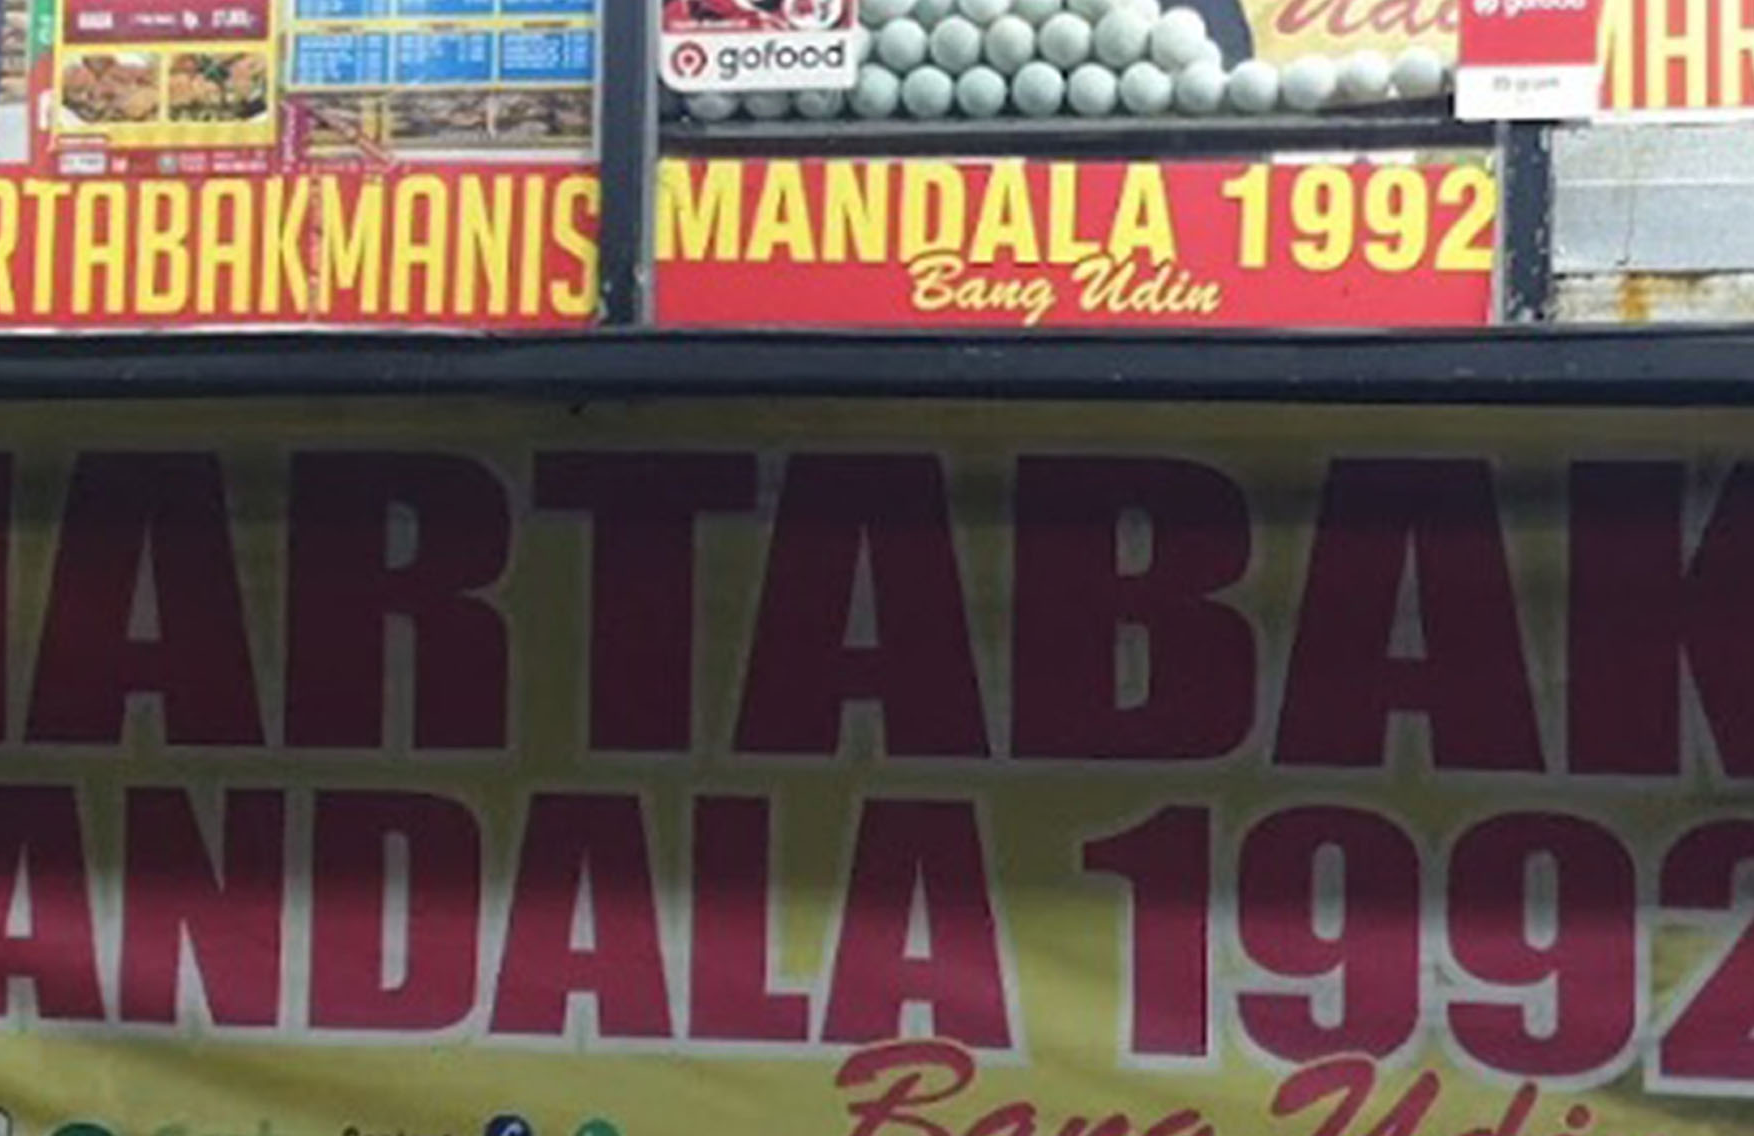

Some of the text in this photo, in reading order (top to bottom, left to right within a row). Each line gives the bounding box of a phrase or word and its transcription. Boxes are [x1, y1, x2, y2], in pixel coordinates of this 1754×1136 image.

[718, 40, 845, 80] gofood
[656, 157, 1496, 272] MANDALA 1992
[908, 251, 1221, 323] Bang Udin
[1082, 802, 1754, 1079] 1992
